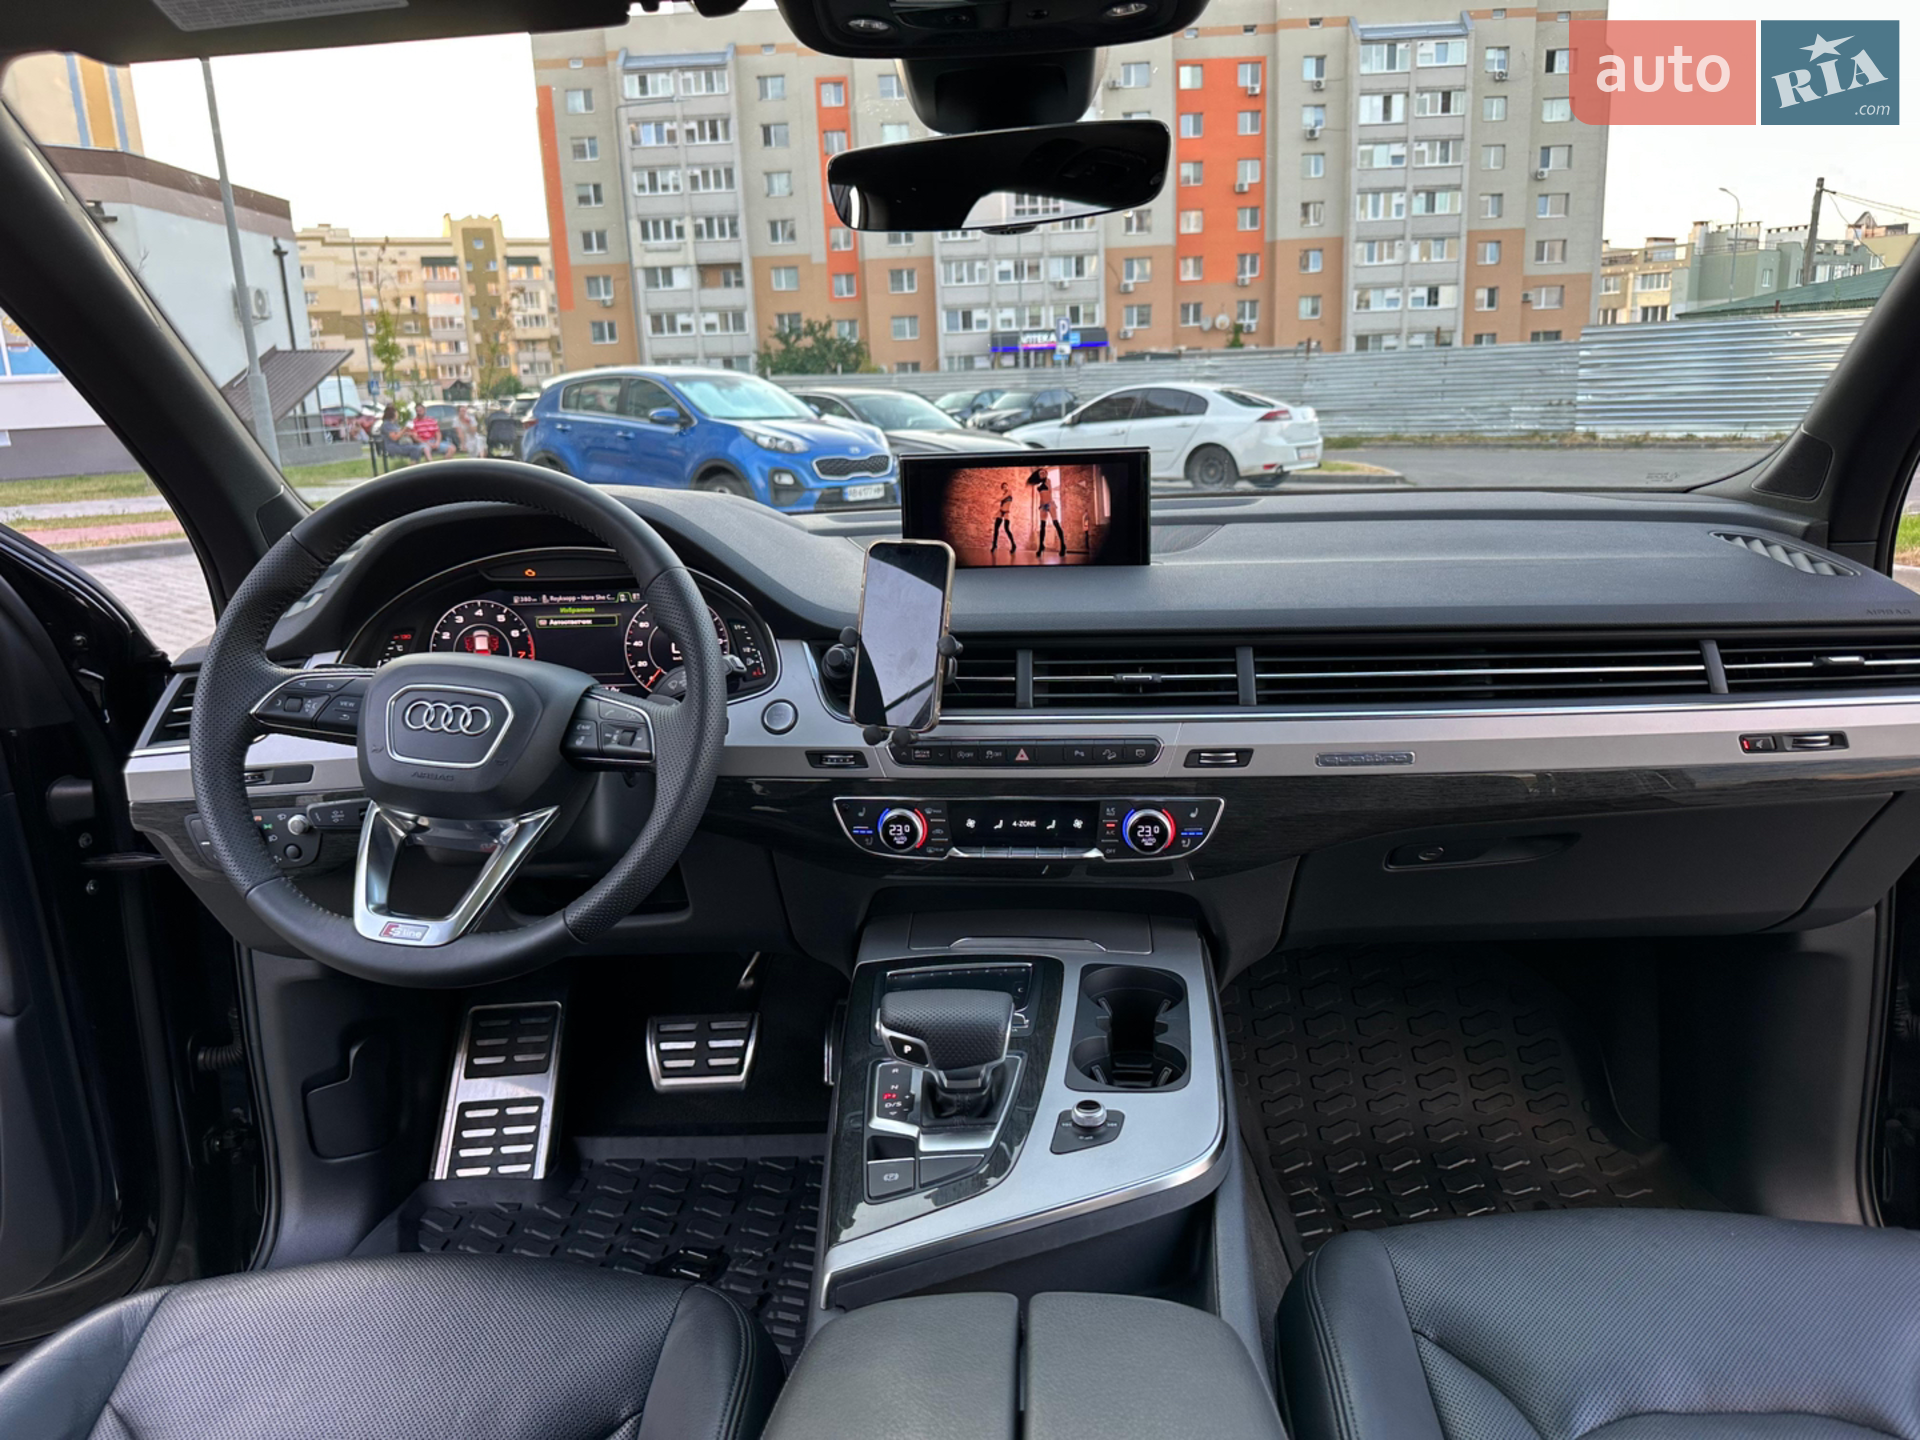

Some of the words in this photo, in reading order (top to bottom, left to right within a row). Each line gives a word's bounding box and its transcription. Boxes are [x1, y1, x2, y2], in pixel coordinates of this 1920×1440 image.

[1059, 319, 1069, 341] P
[474, 608, 484, 617] 4
[454, 615, 464, 624] 3
[496, 614, 506, 623] 5
[441, 631, 451, 640] 2
[510, 629, 520, 638] 6
[518, 650, 526, 660] 7
[1012, 820, 1037, 828] 4-ZONE
[403, 928, 422, 938] line
[903, 1044, 912, 1055] P
